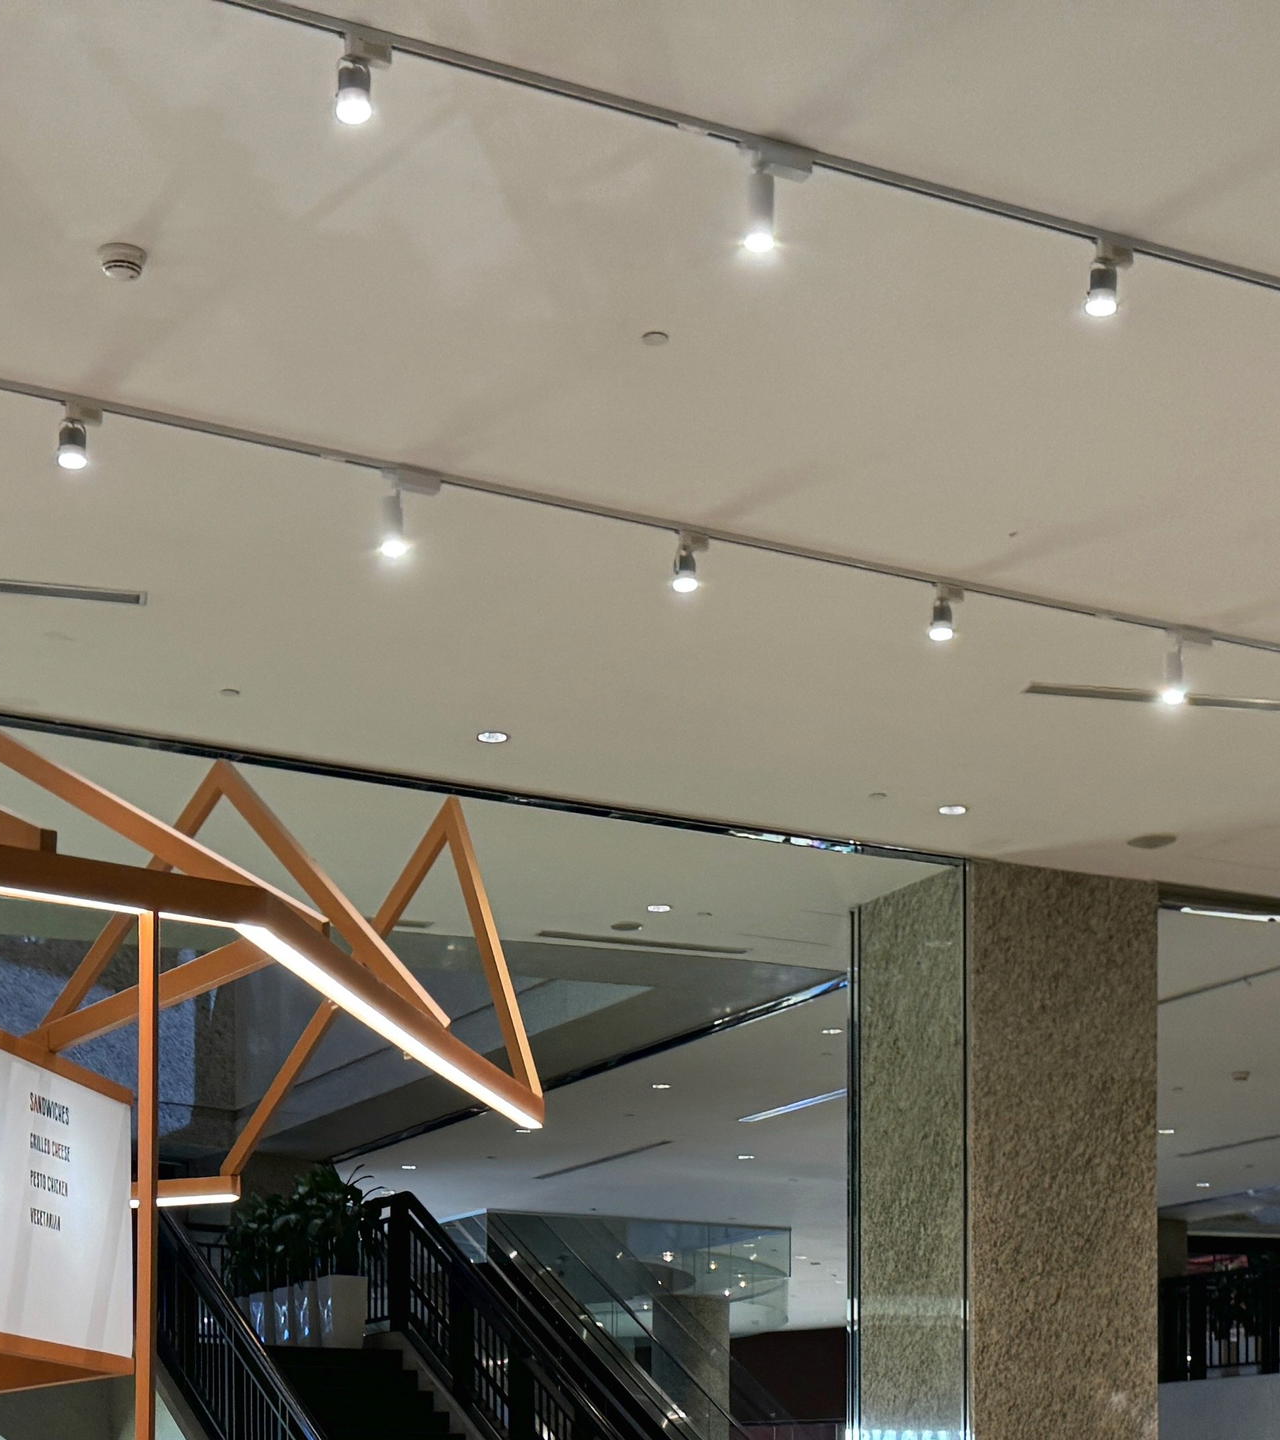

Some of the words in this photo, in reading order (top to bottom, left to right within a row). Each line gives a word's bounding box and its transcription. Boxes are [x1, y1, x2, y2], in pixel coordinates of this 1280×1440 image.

[30, 1092, 69, 1125] SANDWICHES
[52, 1143, 70, 1162] CHEESE
[48, 1176, 68, 1197] CHICKEN
